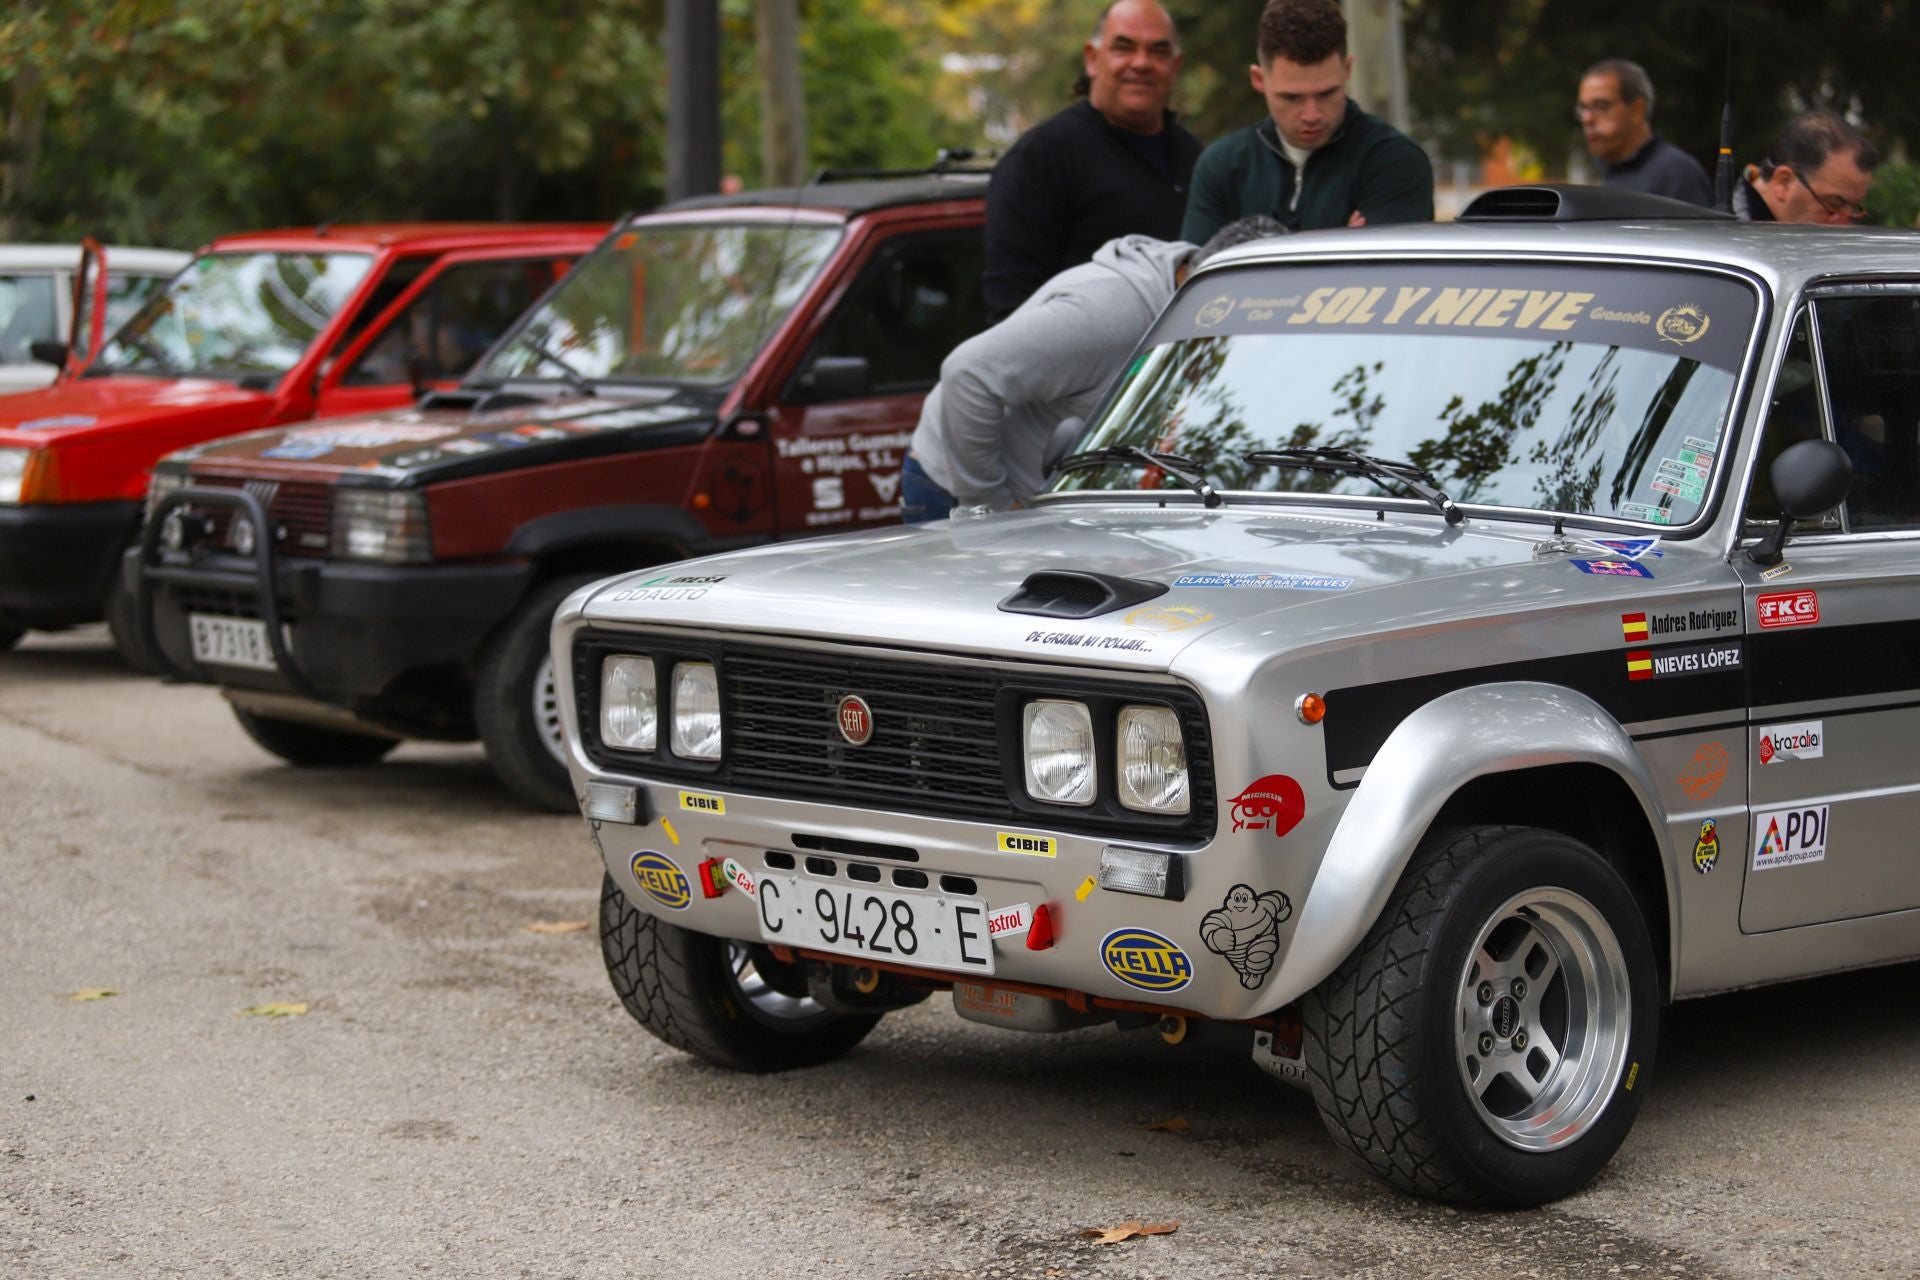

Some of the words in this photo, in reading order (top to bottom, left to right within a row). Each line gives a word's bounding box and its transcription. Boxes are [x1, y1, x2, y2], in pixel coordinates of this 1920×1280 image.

[1286, 287, 1387, 324] SOL
[1382, 287, 1431, 324] Y
[1414, 287, 1595, 330] NIEVE
[1590, 306, 1651, 324] Granada
[1766, 565, 1789, 577] DUNLOP
[1232, 578, 1298, 587] PRIMERAS
[1301, 579, 1349, 587] NIEVES
[612, 589, 708, 602] DDAUTO
[1765, 598, 1810, 617] FKG
[1652, 614, 1686, 635] Andres
[1689, 608, 1737, 631] Rodriguez
[1025, 631, 1046, 642] DE
[1043, 632, 1084, 646] GRANA
[1082, 636, 1099, 647] NI
[1654, 653, 1699, 675] NIEVES
[1700, 648, 1740, 669] LÓPEZ
[843, 709, 863, 733] SEAT
[1774, 729, 1818, 751] trazalia
[686, 796, 719, 810] CIBIE
[1241, 792, 1283, 803] MICHELIN
[1757, 807, 1827, 856] APDI
[1756, 849, 1823, 867] www.apdigroup.com
[636, 869, 691, 900] HELLA
[737, 873, 756, 896] Cas
[989, 911, 1022, 933] astrol
[1108, 950, 1191, 977] HELLA
